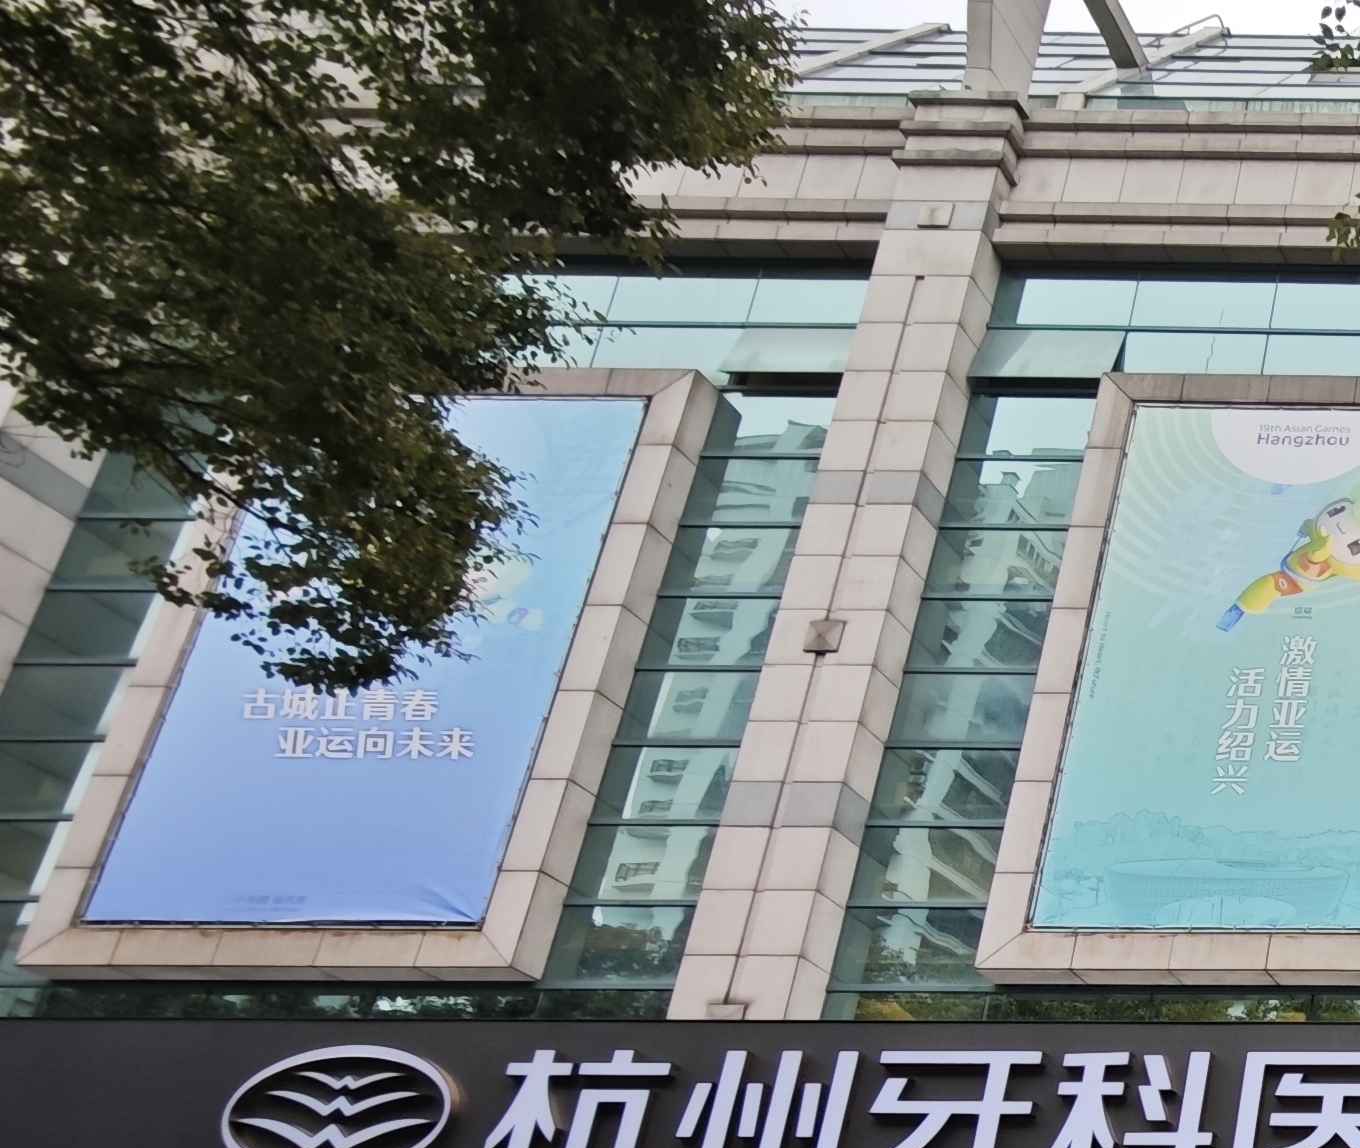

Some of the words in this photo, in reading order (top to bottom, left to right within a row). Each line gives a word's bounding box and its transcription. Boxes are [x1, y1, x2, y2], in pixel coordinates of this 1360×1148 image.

[1256, 432, 1350, 448] Hangzhou
[1259, 424, 1282, 433] 19th
[1284, 424, 1313, 433] Asian
[1314, 425, 1351, 434] Games
[1263, 635, 1318, 763] 激情亚运
[274, 726, 476, 760] 亚运向未来
[1210, 667, 1266, 796] 活力绍兴
